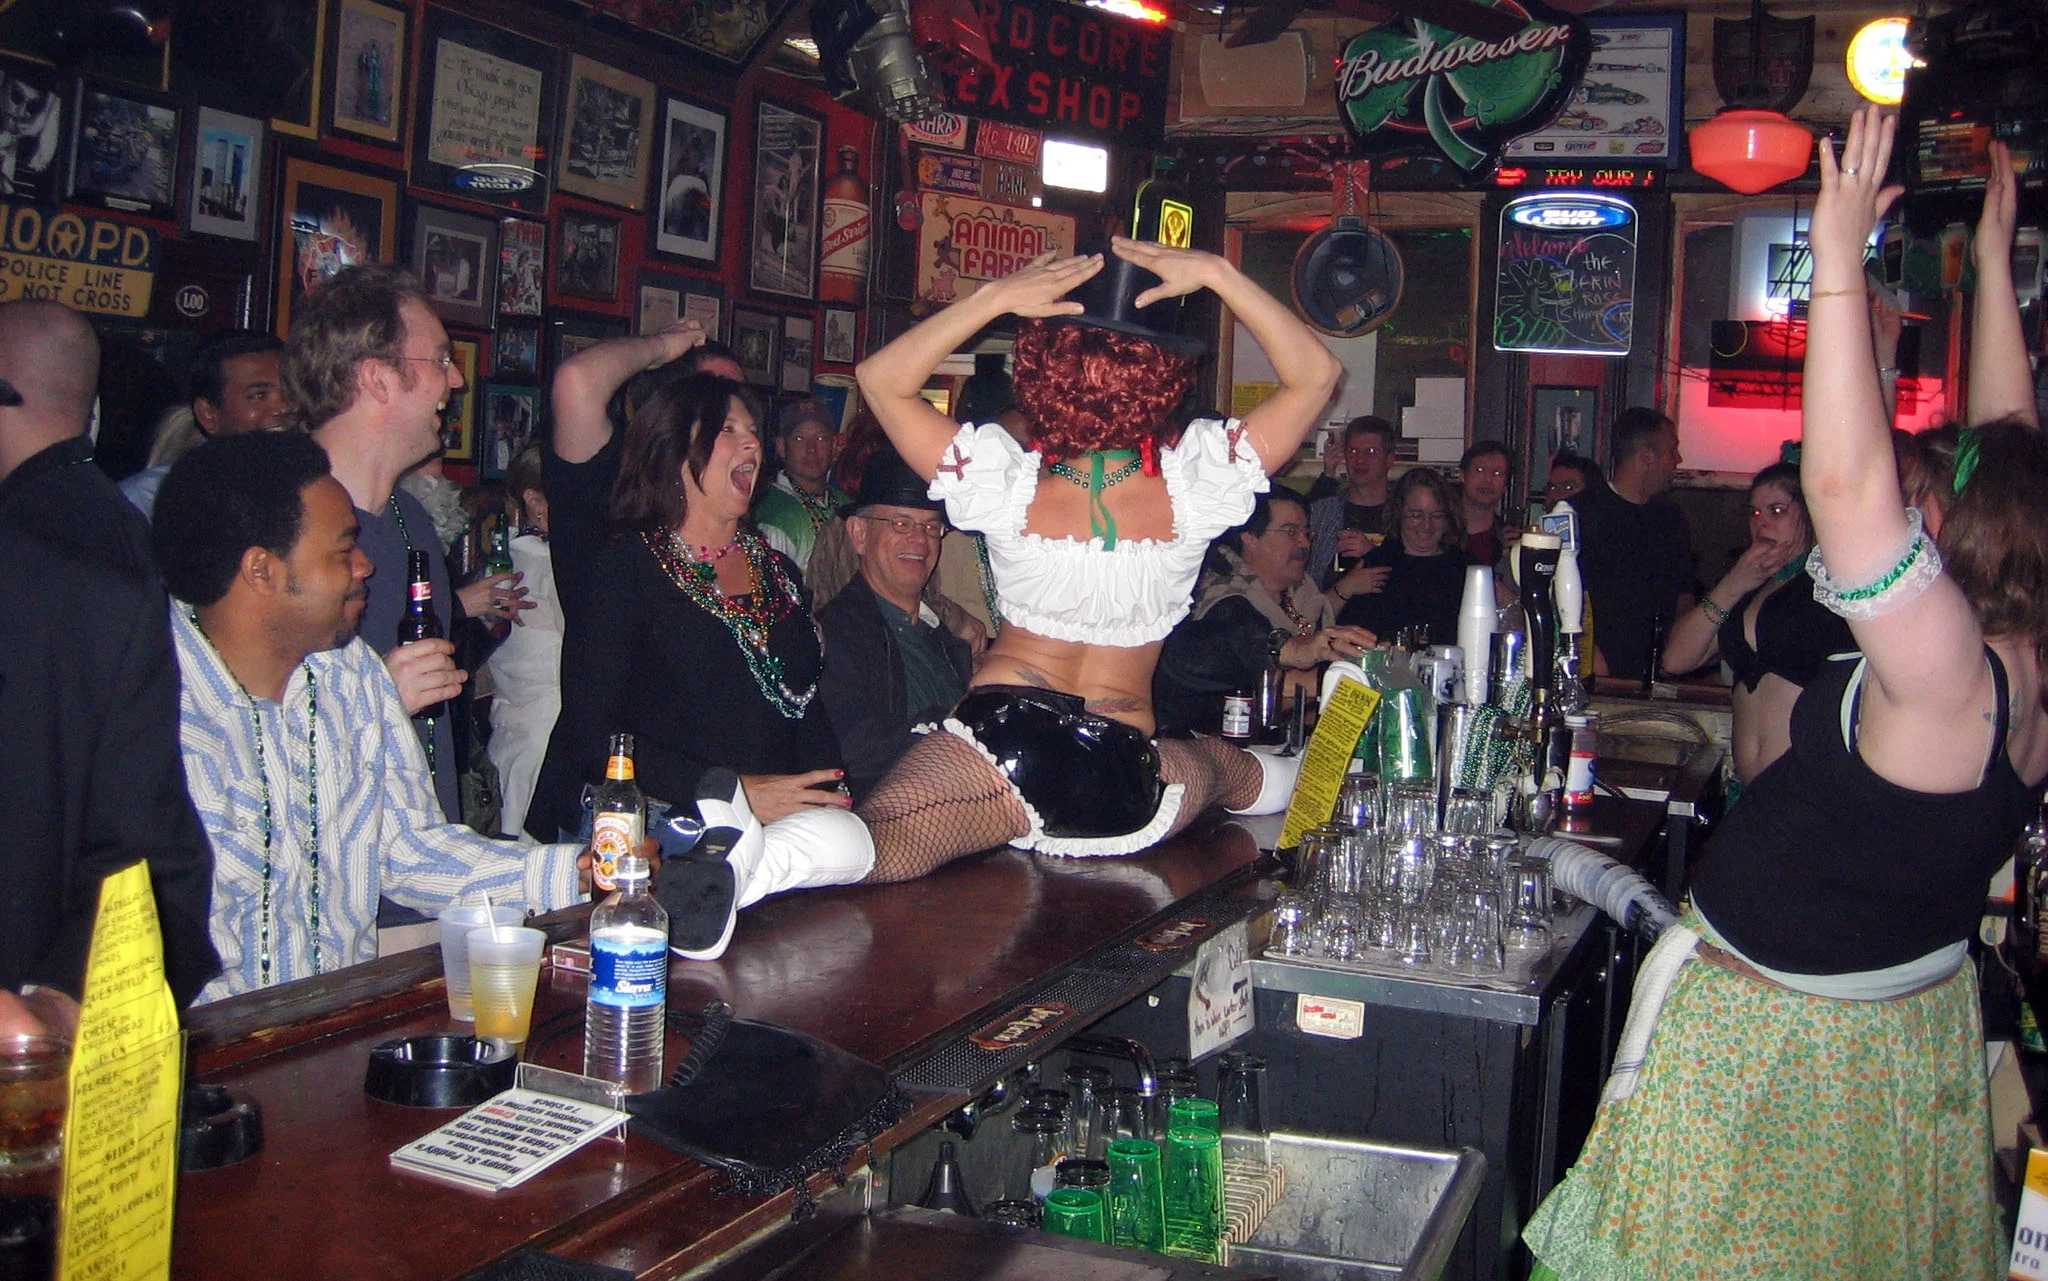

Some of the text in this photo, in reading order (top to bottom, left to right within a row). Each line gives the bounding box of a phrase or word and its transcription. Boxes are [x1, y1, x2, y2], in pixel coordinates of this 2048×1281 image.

[981, 0, 1159, 77] RDCORE
[1340, 23, 1571, 101] Budweiser
[957, 62, 1142, 131] EX SHOP
[914, 113, 956, 136] NHRA
[1006, 130, 1038, 157] 1402
[1545, 169, 1634, 185] TRY OUR
[1532, 217, 1606, 226] LIGHT
[1542, 210, 1597, 218] BUD
[0, 203, 150, 267] .O. P.D.
[955, 217, 1043, 257] ANIMAL
[0, 256, 125, 291] POLICE LINE
[22, 282, 62, 300] NOT
[72, 287, 132, 312] CROSS
[615, 980, 655, 994] Sierra
[532, 1098, 573, 1111] o'clock
[480, 1106, 584, 1135] Annual Irish Crawl
[481, 1127, 519, 1142] March
[520, 1135, 560, 1151] Friday
[414, 1143, 463, 1161] Paddy's
[479, 1146, 517, 1162] Parade
[517, 1146, 546, 1159] Party
[479, 1157, 522, 1175] Happy
